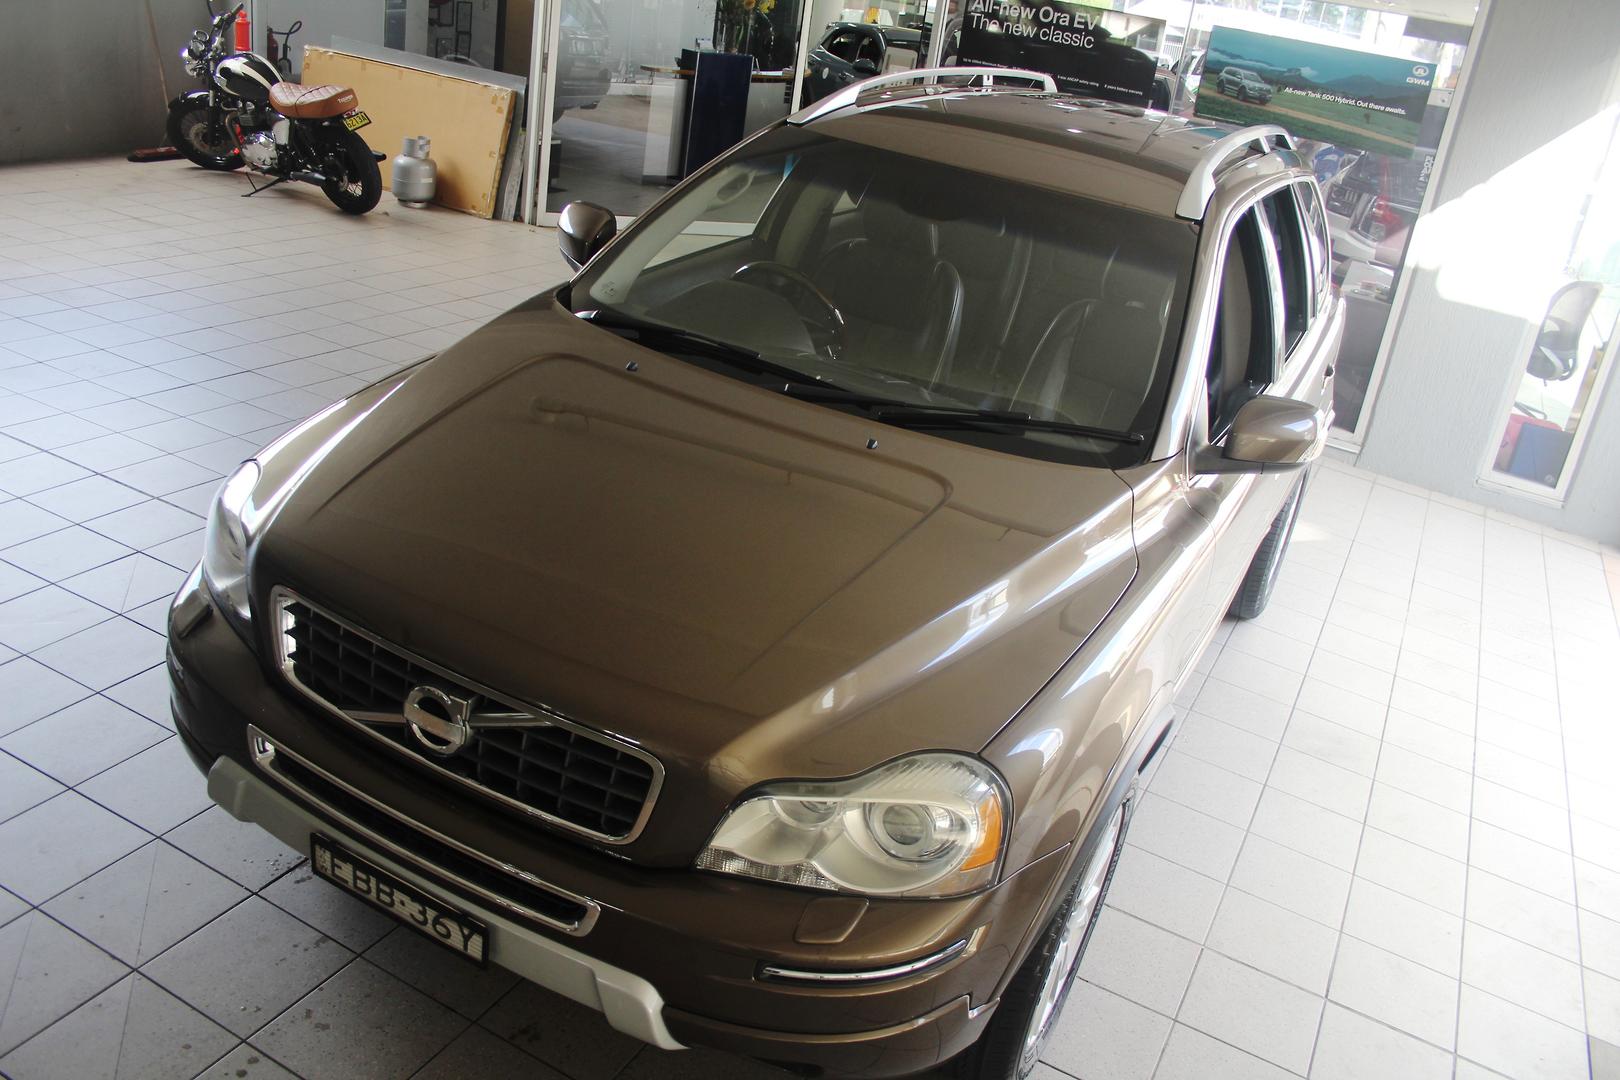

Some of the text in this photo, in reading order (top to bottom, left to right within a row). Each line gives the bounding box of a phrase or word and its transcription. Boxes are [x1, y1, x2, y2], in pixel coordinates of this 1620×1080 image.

[971, 0, 1100, 31] All-new Ora EV
[970, 12, 1095, 49] The new classic
[1406, 77, 1430, 86] GWM
[1284, 87, 1307, 96] All-new
[1307, 91, 1322, 100] Tank
[1356, 100, 1368, 108] Out
[1368, 102, 1385, 111] there
